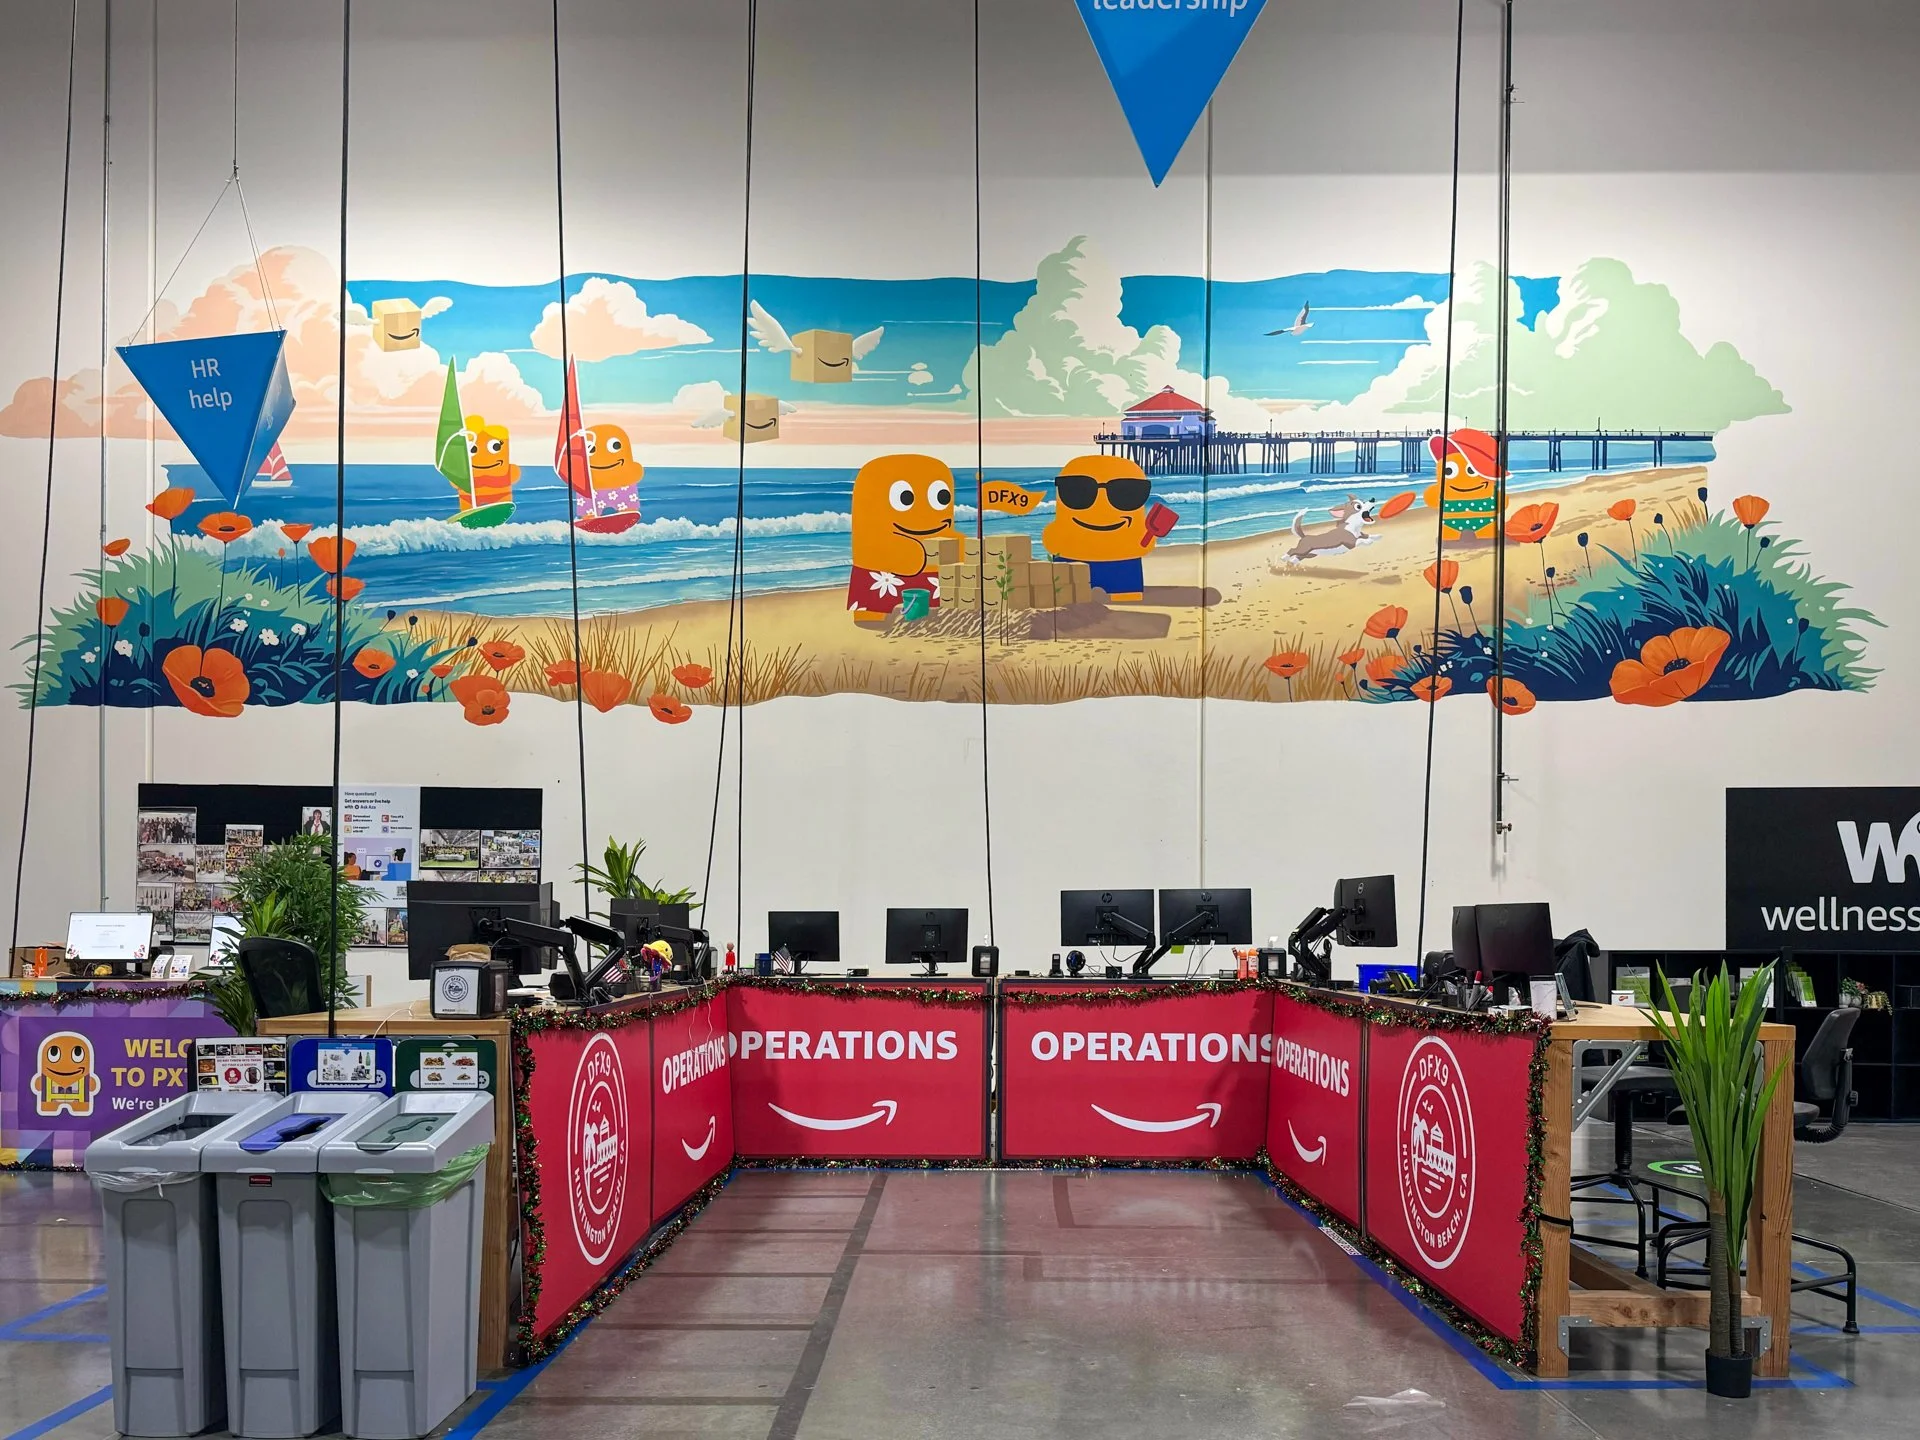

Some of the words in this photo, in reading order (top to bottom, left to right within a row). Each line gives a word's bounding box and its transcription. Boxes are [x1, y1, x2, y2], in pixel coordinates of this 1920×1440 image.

[191, 358, 221, 379] HR
[188, 387, 233, 412] help
[988, 489, 1029, 508] DFX9
[1760, 896, 1920, 932] wellness
[124, 1038, 193, 1058] WELC
[662, 1035, 726, 1094] OPERATIONS
[110, 1067, 146, 1087] TO
[152, 1067, 188, 1087] PX
[587, 1050, 612, 1086] DFX9
[1276, 1036, 1350, 1097] OPERATIONS
[1418, 1053, 1450, 1087] DFX9
[111, 1097, 154, 1110] We're
[574, 1167, 606, 1245] HUNTINGTON
[606, 1174, 623, 1237] BEACH,
[619, 1139, 625, 1164] CA
[1403, 1144, 1435, 1248] HUNTINGTON
[1437, 1208, 1463, 1249] BEACH,
[1459, 1172, 1468, 1200] CA
